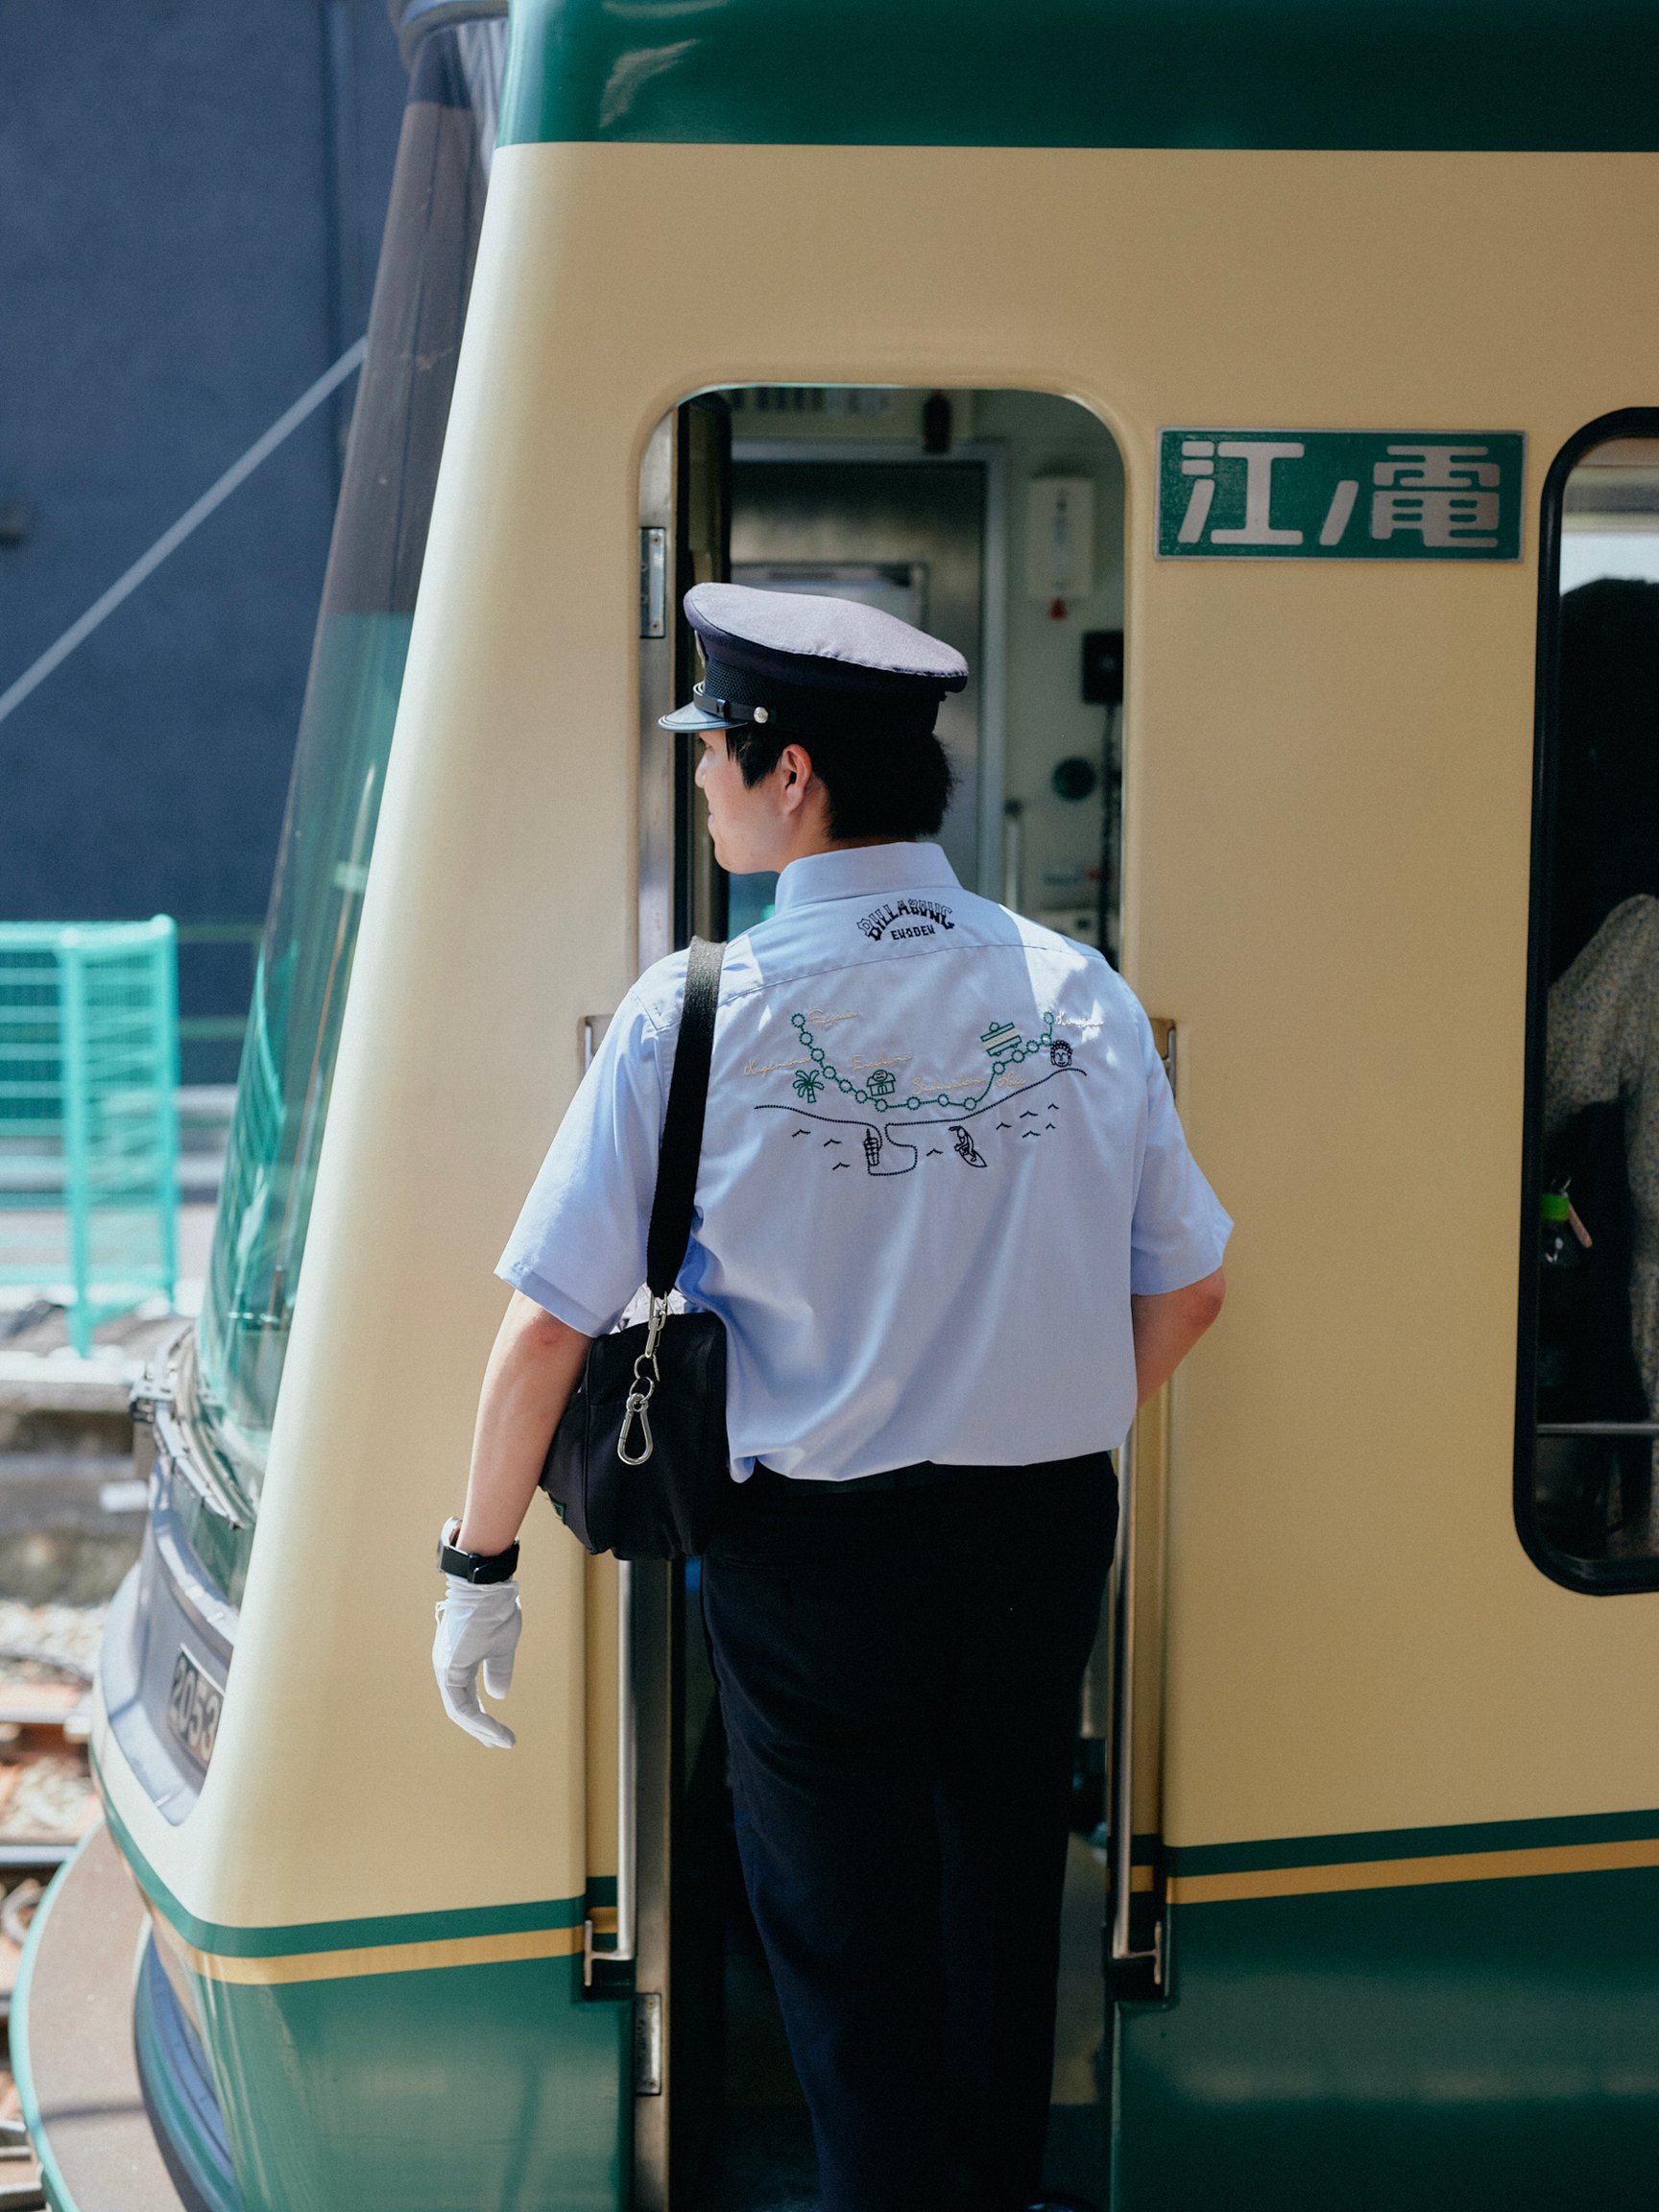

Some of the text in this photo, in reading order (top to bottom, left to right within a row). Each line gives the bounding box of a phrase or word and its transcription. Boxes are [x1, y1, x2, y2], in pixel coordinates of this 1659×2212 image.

[1177, 441, 1501, 547] 江ノ電
[856, 899, 956, 942] BILLABONG
[890, 924, 936, 941] ENODEN
